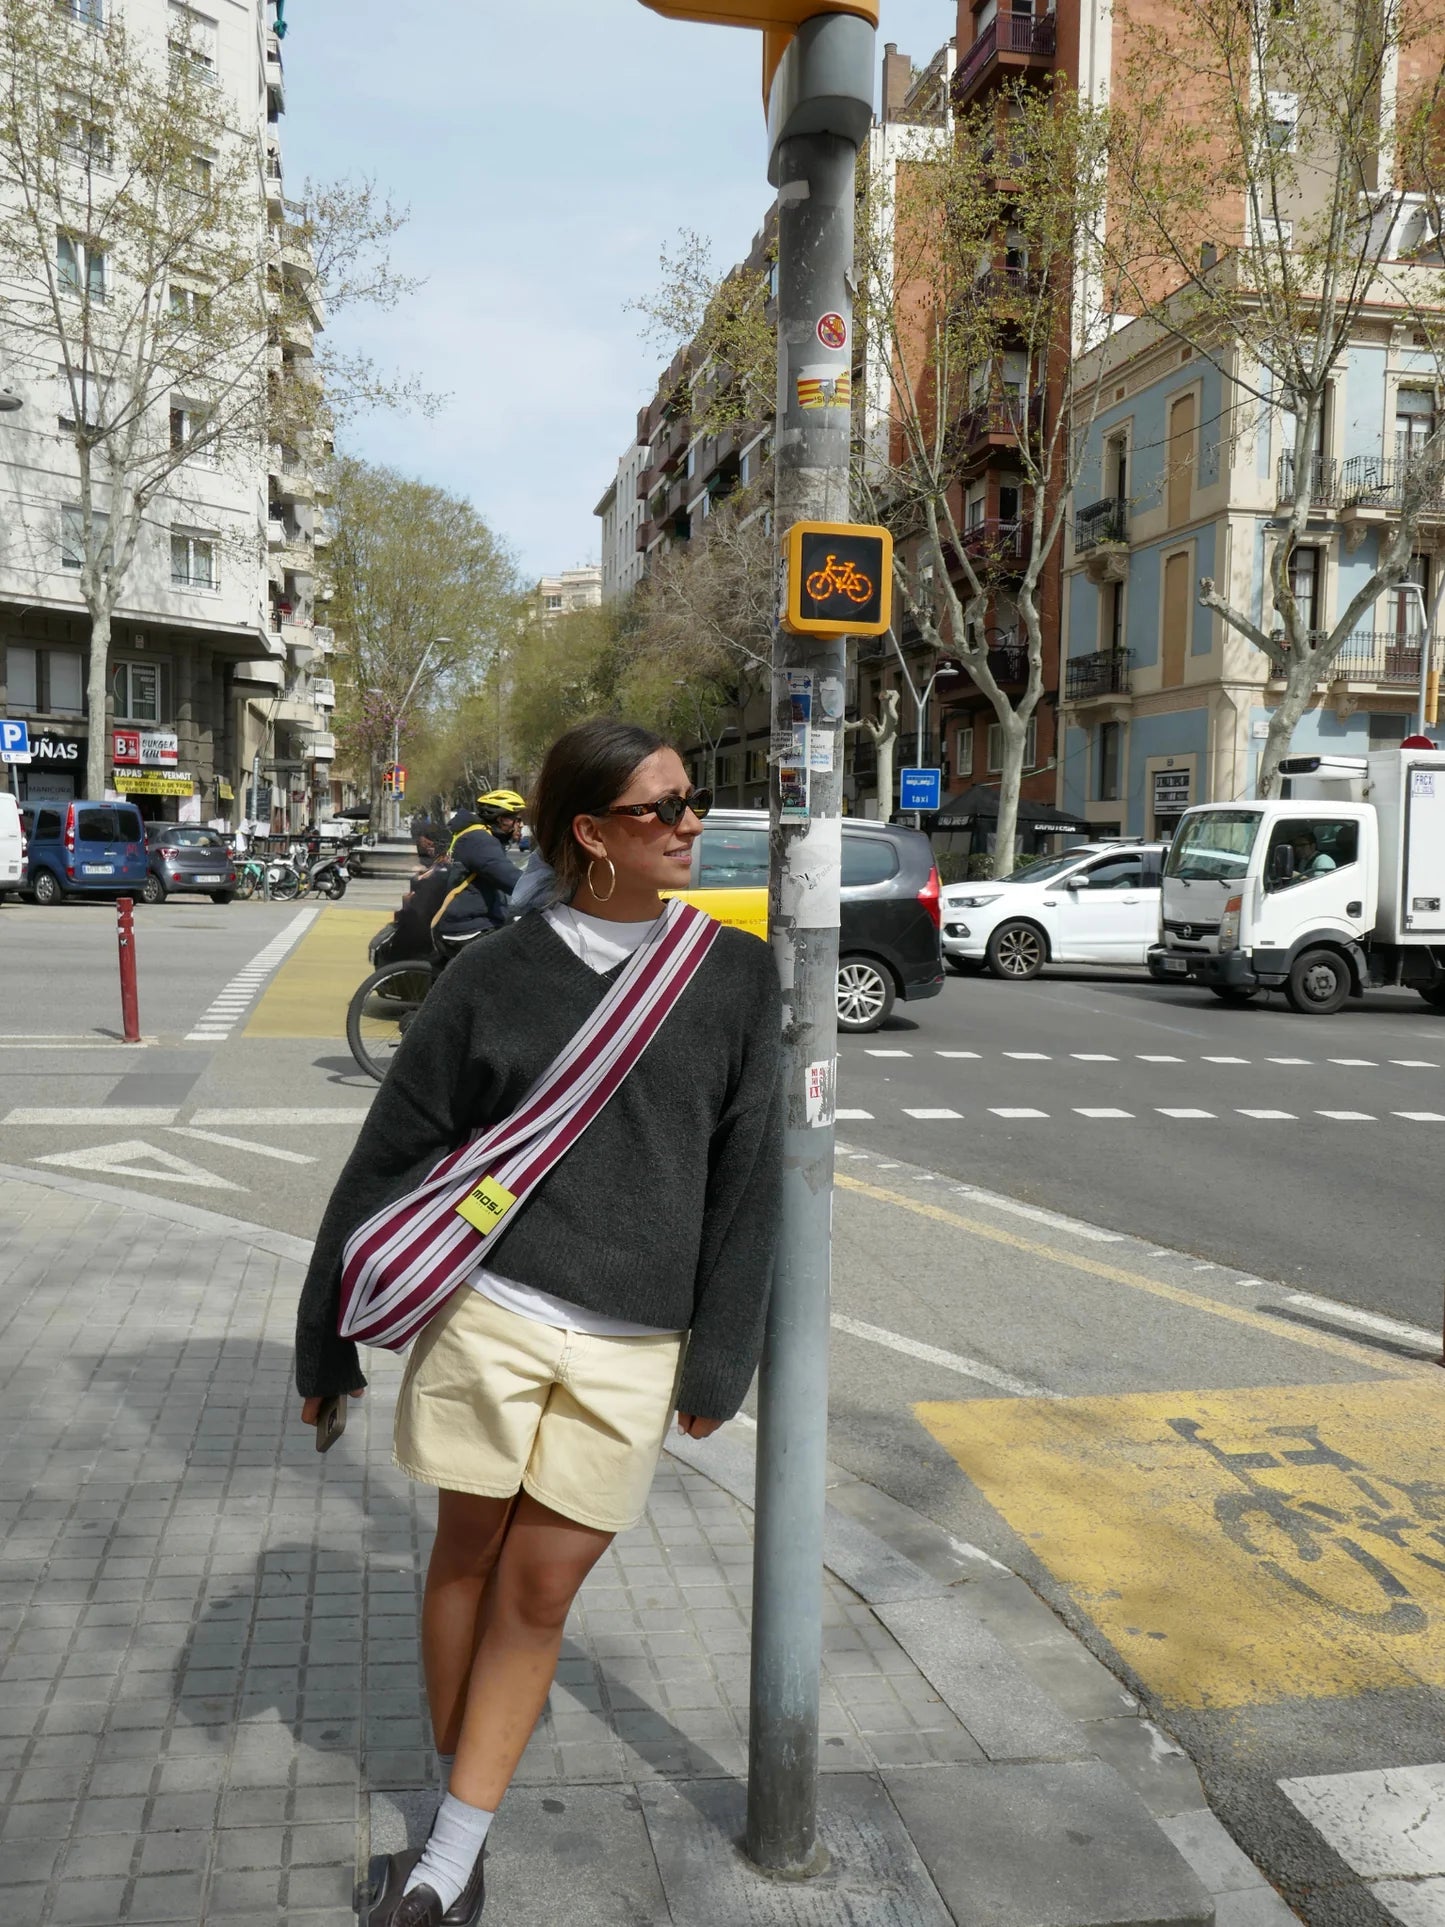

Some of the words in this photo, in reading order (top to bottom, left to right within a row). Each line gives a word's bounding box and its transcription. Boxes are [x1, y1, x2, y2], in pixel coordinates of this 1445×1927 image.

[3, 723, 22, 749] P
[28, 738, 78, 759] UÑAS
[142, 739, 175, 750] BURGER
[114, 768, 142, 778] TAPAS
[162, 771, 192, 780] VERMUT
[911, 795, 929, 803] taxi
[472, 1188, 503, 1216] MOSJ
